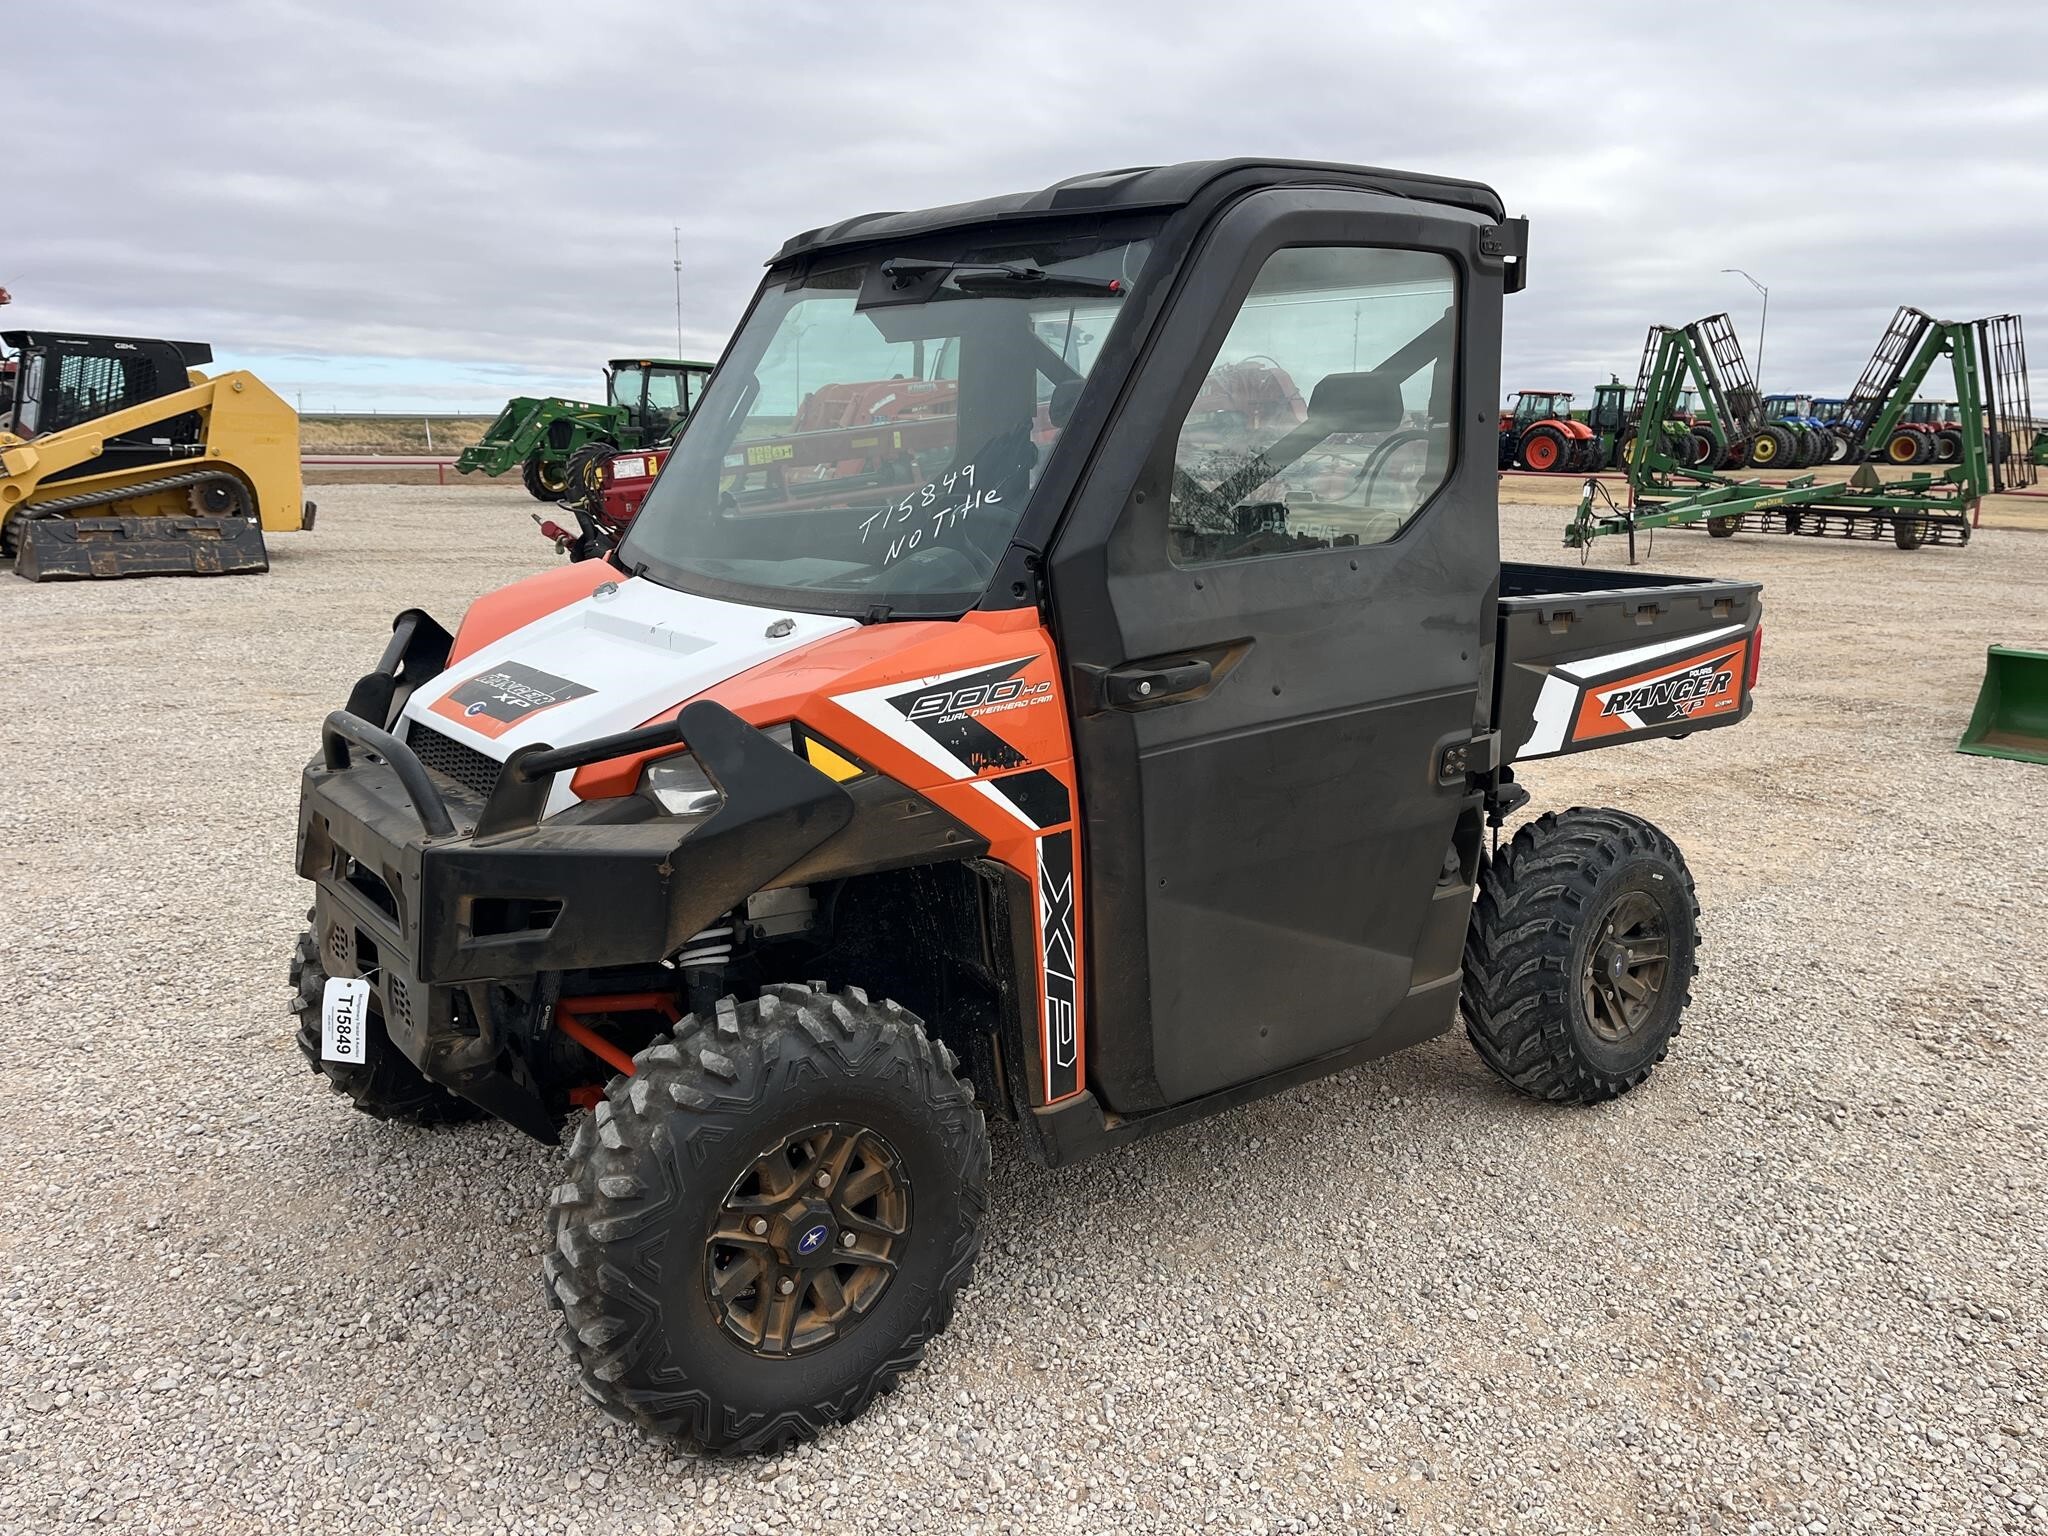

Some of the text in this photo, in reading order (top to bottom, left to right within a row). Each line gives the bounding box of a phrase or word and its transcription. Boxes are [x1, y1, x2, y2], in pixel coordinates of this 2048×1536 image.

[859, 464, 975, 544] T15849
[933, 489, 1003, 538] Title
[475, 674, 556, 705] RANGER
[1600, 670, 1733, 717] RANGER
[1689, 667, 1713, 678] POLARIS
[492, 693, 531, 708] XP
[905, 678, 1051, 722] 900 HO
[938, 695, 1054, 724] DUAL OVERHEAD CAM
[1666, 698, 1705, 719] XP
[1037, 848, 1077, 1067] XP
[336, 995, 354, 1055] T15849
